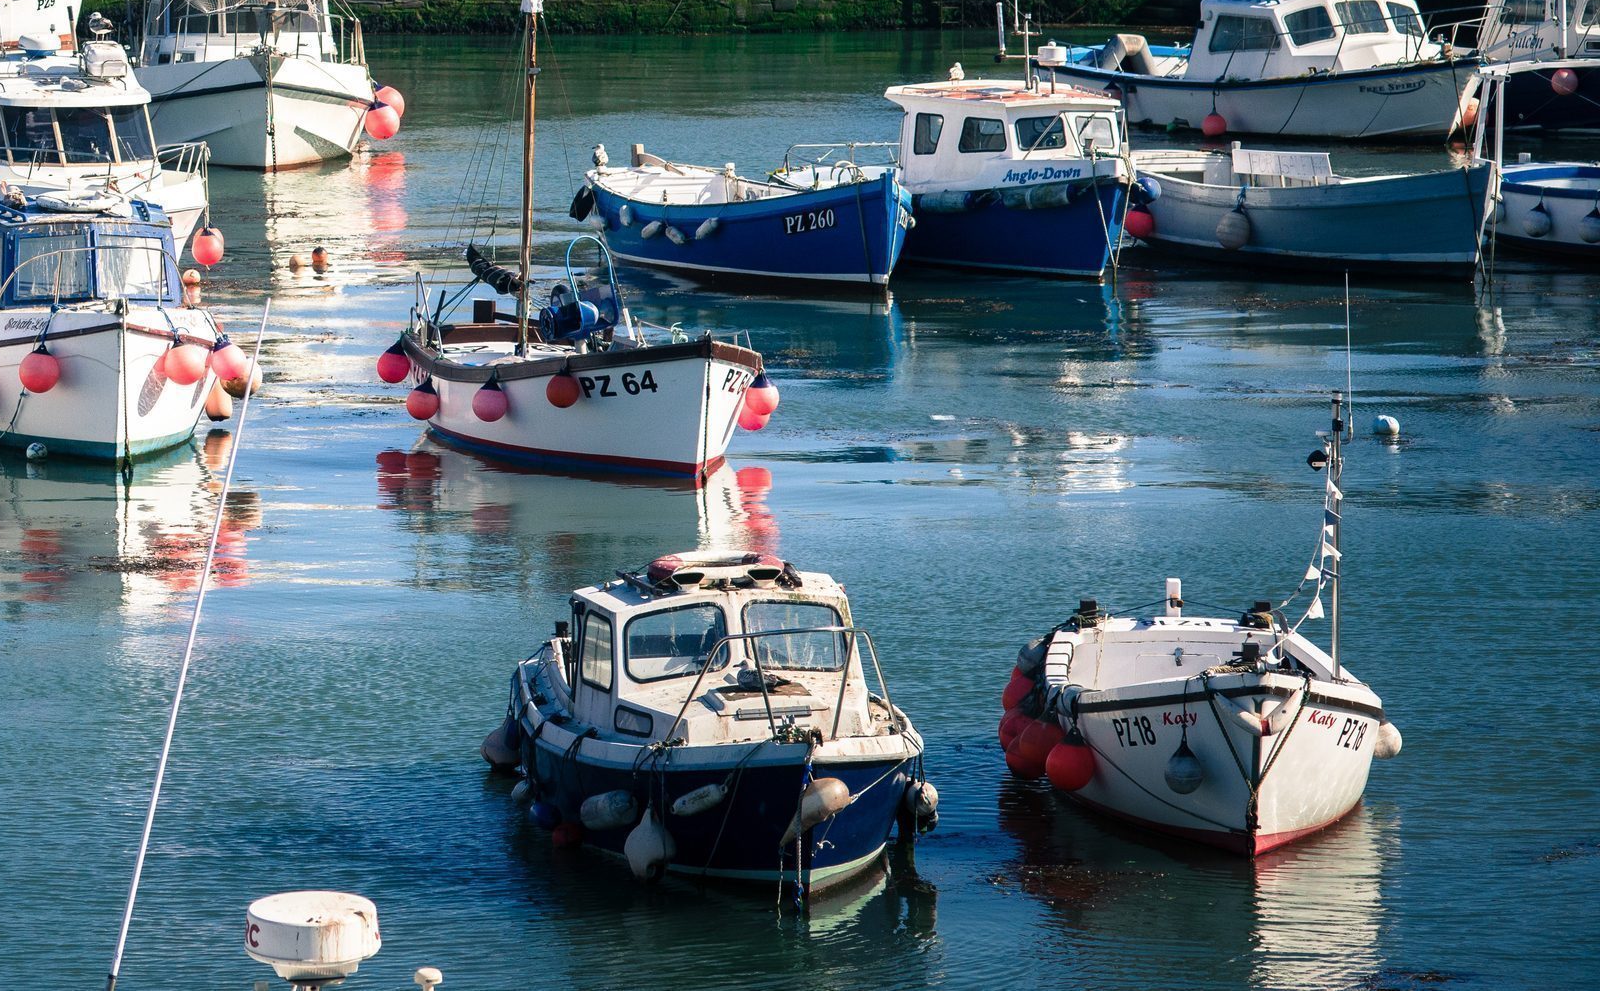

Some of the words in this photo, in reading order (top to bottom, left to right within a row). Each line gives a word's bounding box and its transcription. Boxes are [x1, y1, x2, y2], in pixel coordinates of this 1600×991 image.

[1002, 167, 1082, 185] Anglo-Dawn
[785, 214, 805, 234] PZ
[808, 209, 835, 230] 260
[579, 375, 617, 399] PZ
[621, 370, 659, 396] 64
[722, 368, 743, 393] PZ
[1112, 715, 1157, 748] PZ18
[1163, 712, 1197, 726] Katy
[1307, 710, 1337, 729] Katy
[1336, 717, 1368, 751] PZ18
